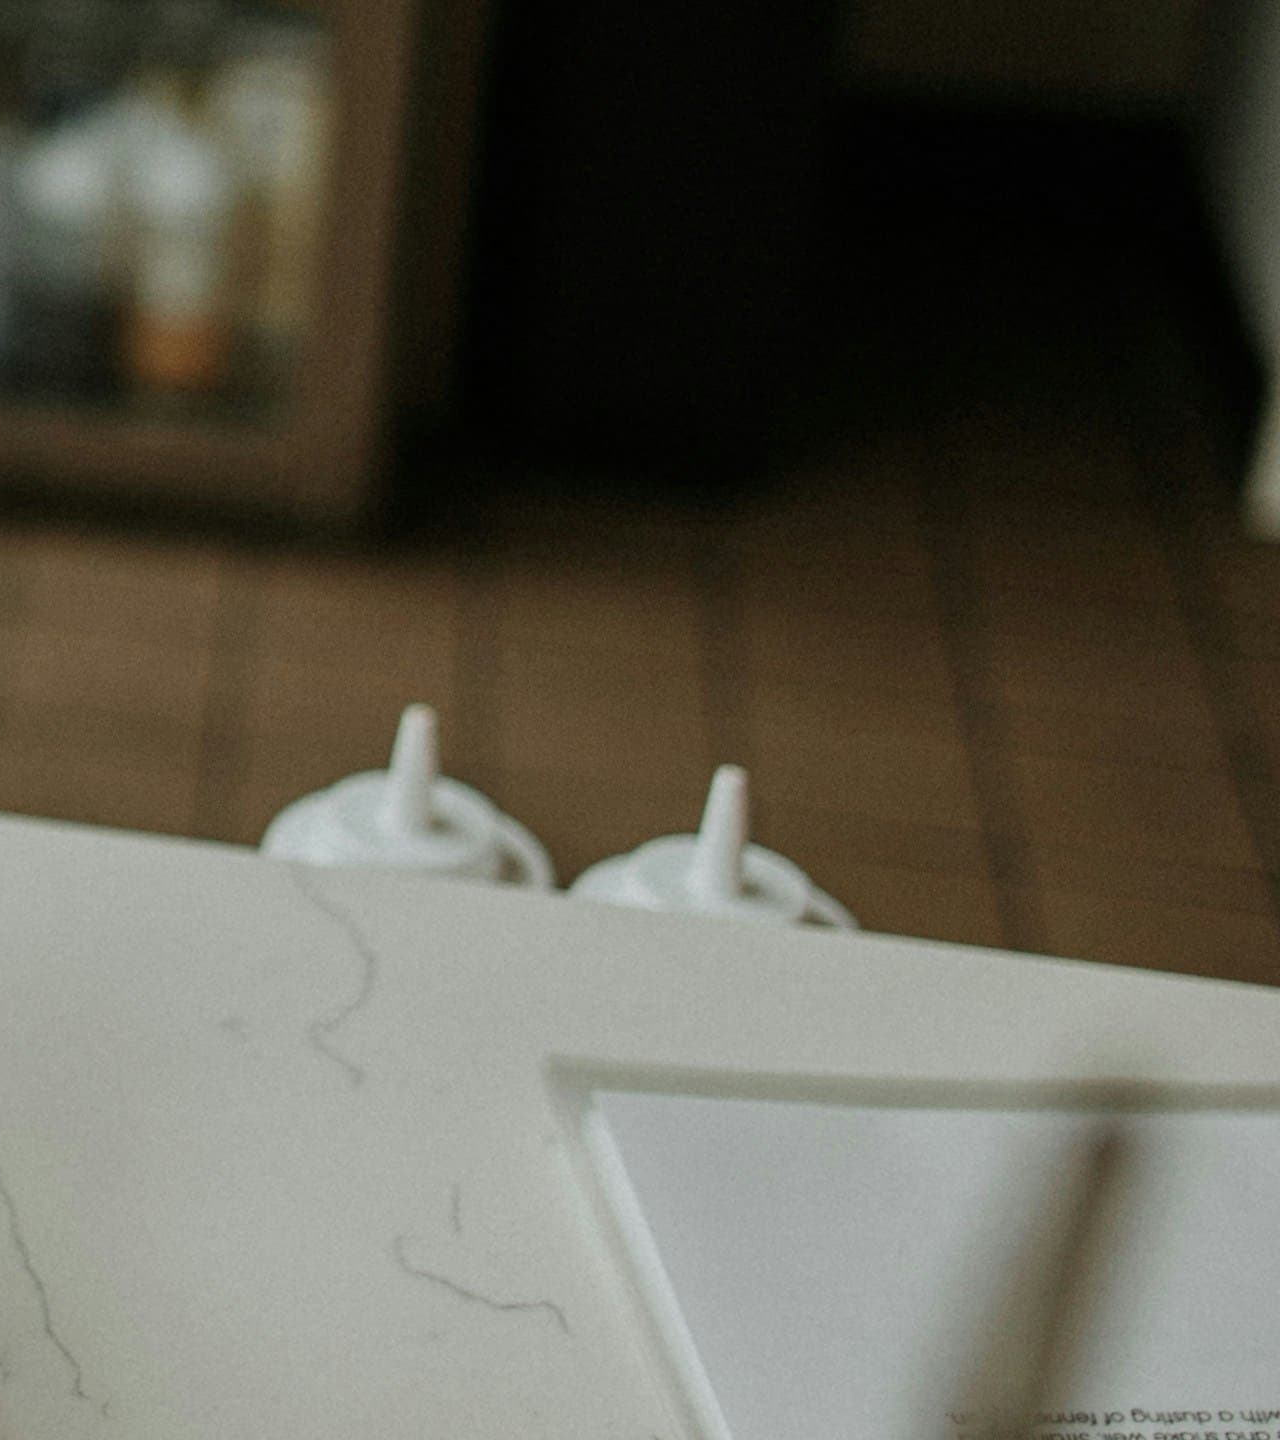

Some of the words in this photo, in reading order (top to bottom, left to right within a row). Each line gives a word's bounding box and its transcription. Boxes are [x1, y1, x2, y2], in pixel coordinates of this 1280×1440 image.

[1104, 1411, 1126, 1427] of
[1130, 1407, 1212, 1425] dusting
[1218, 1409, 1234, 1423] a
[1240, 1409, 1280, 1424] with
